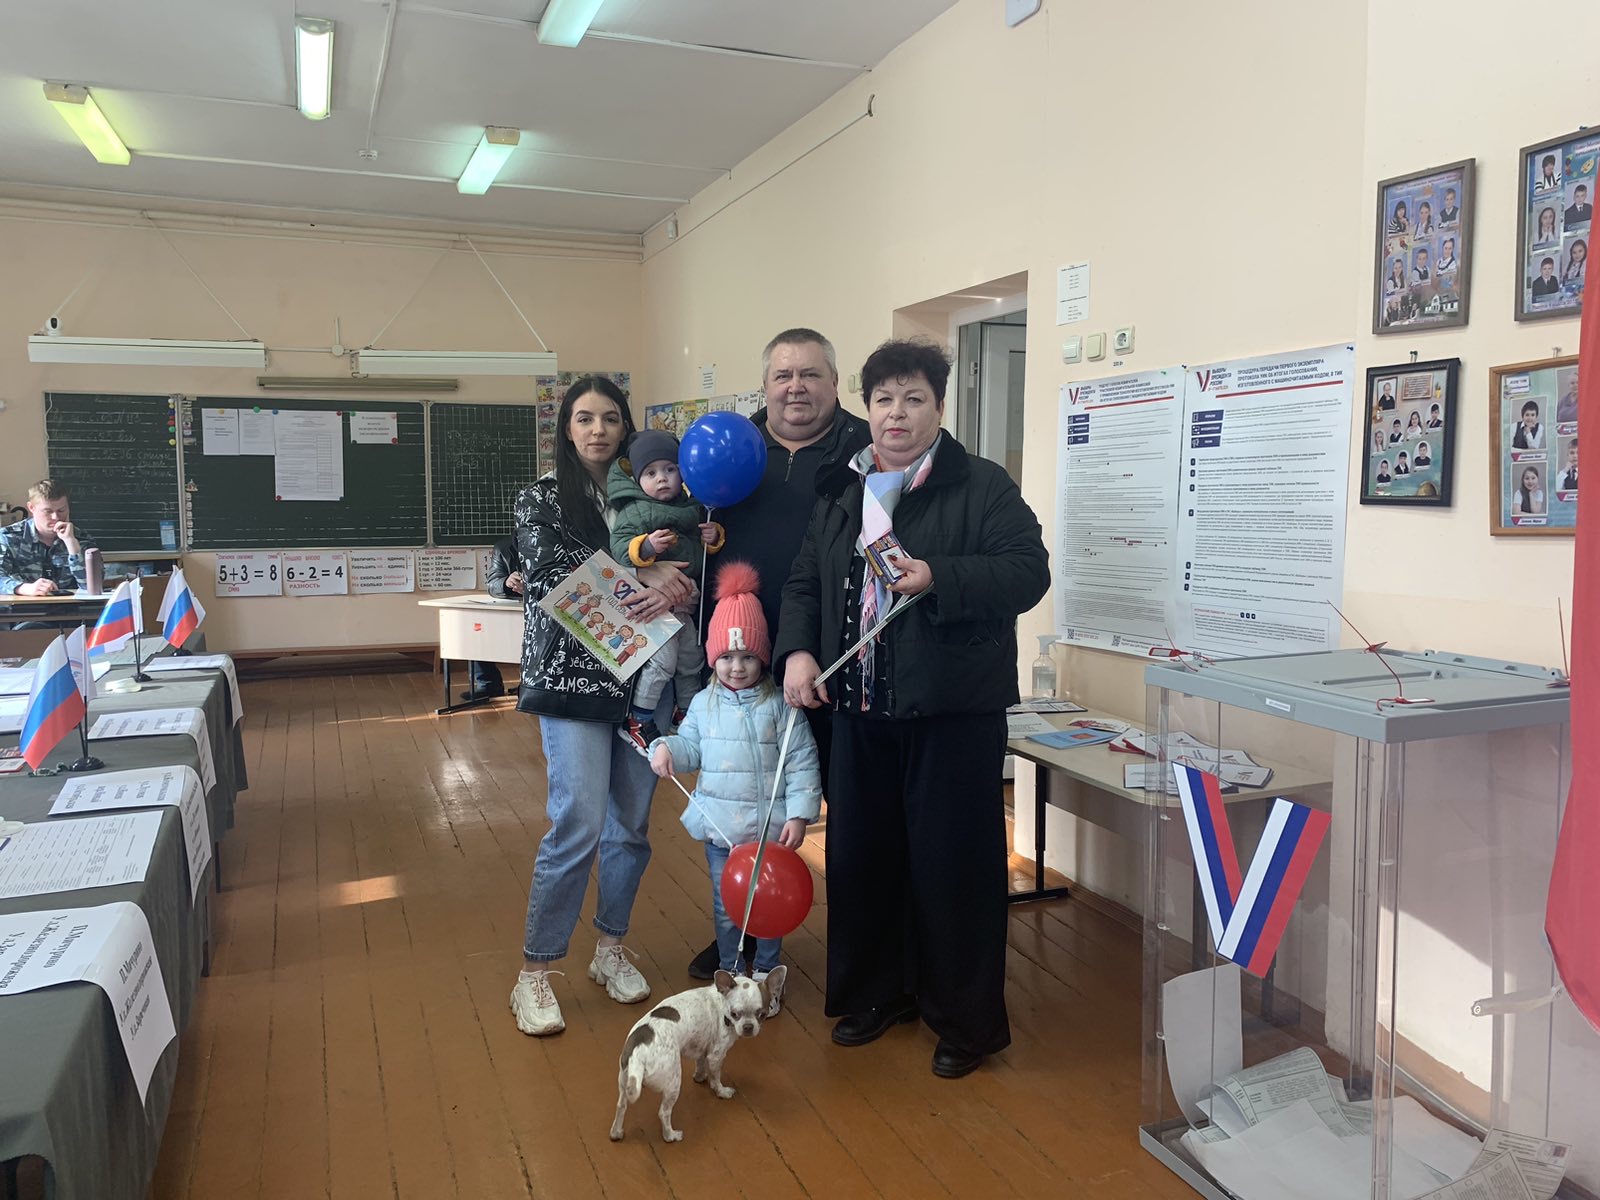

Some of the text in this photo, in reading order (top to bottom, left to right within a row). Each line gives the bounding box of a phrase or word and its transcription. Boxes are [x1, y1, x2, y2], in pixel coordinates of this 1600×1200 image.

[269, 564, 277, 581] 8
[335, 565, 343, 578] 4
[728, 627, 746, 651] R
[44, 924, 89, 968] П.Мичурино
